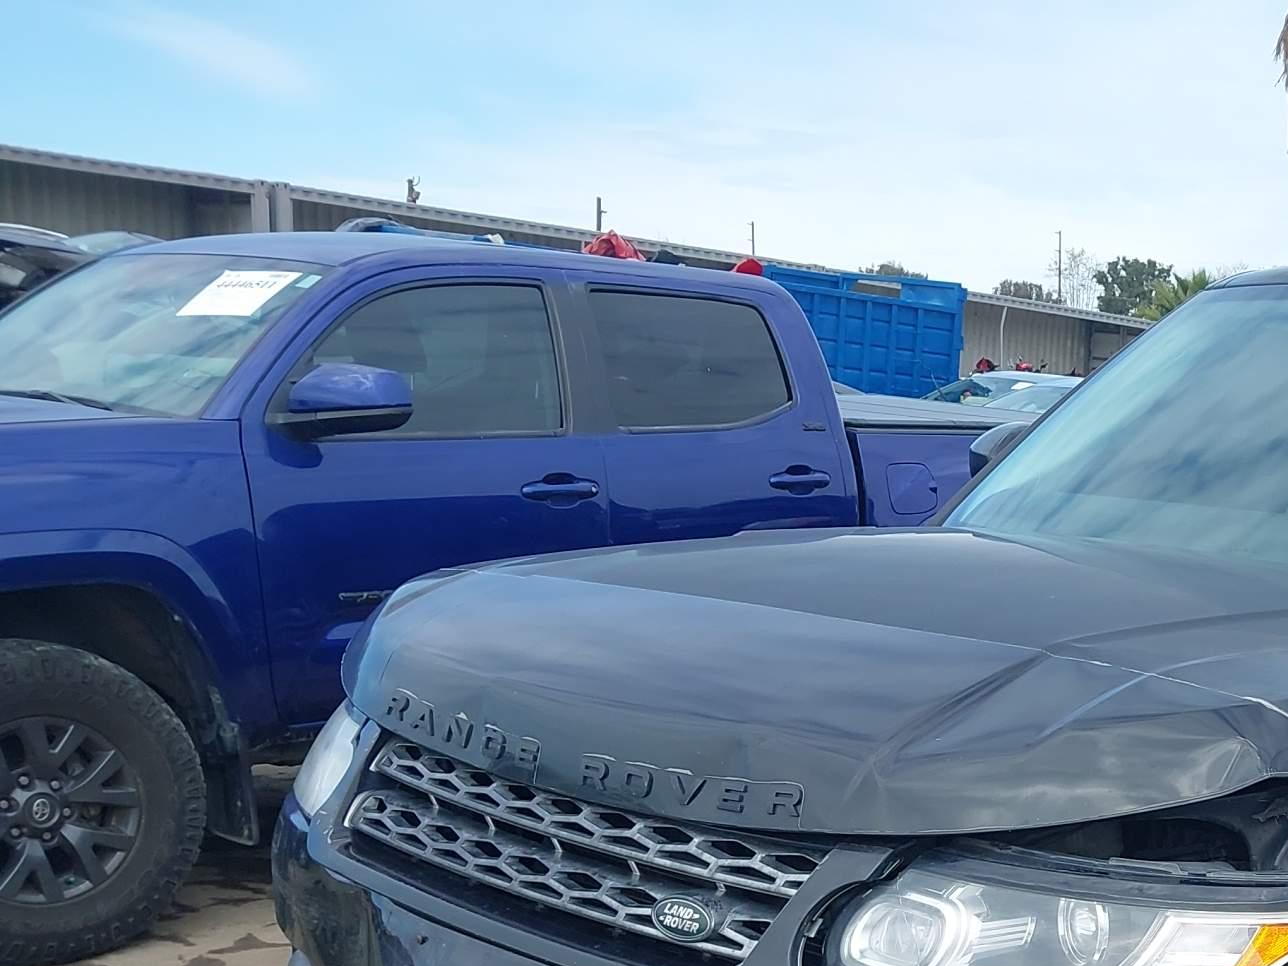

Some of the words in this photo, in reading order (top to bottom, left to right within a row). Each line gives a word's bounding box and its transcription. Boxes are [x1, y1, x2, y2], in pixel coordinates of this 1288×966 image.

[385, 689, 540, 772] RANGE
[581, 754, 804, 818] ROVER
[664, 903, 694, 919] LAND
[663, 914, 700, 934] ROVER
